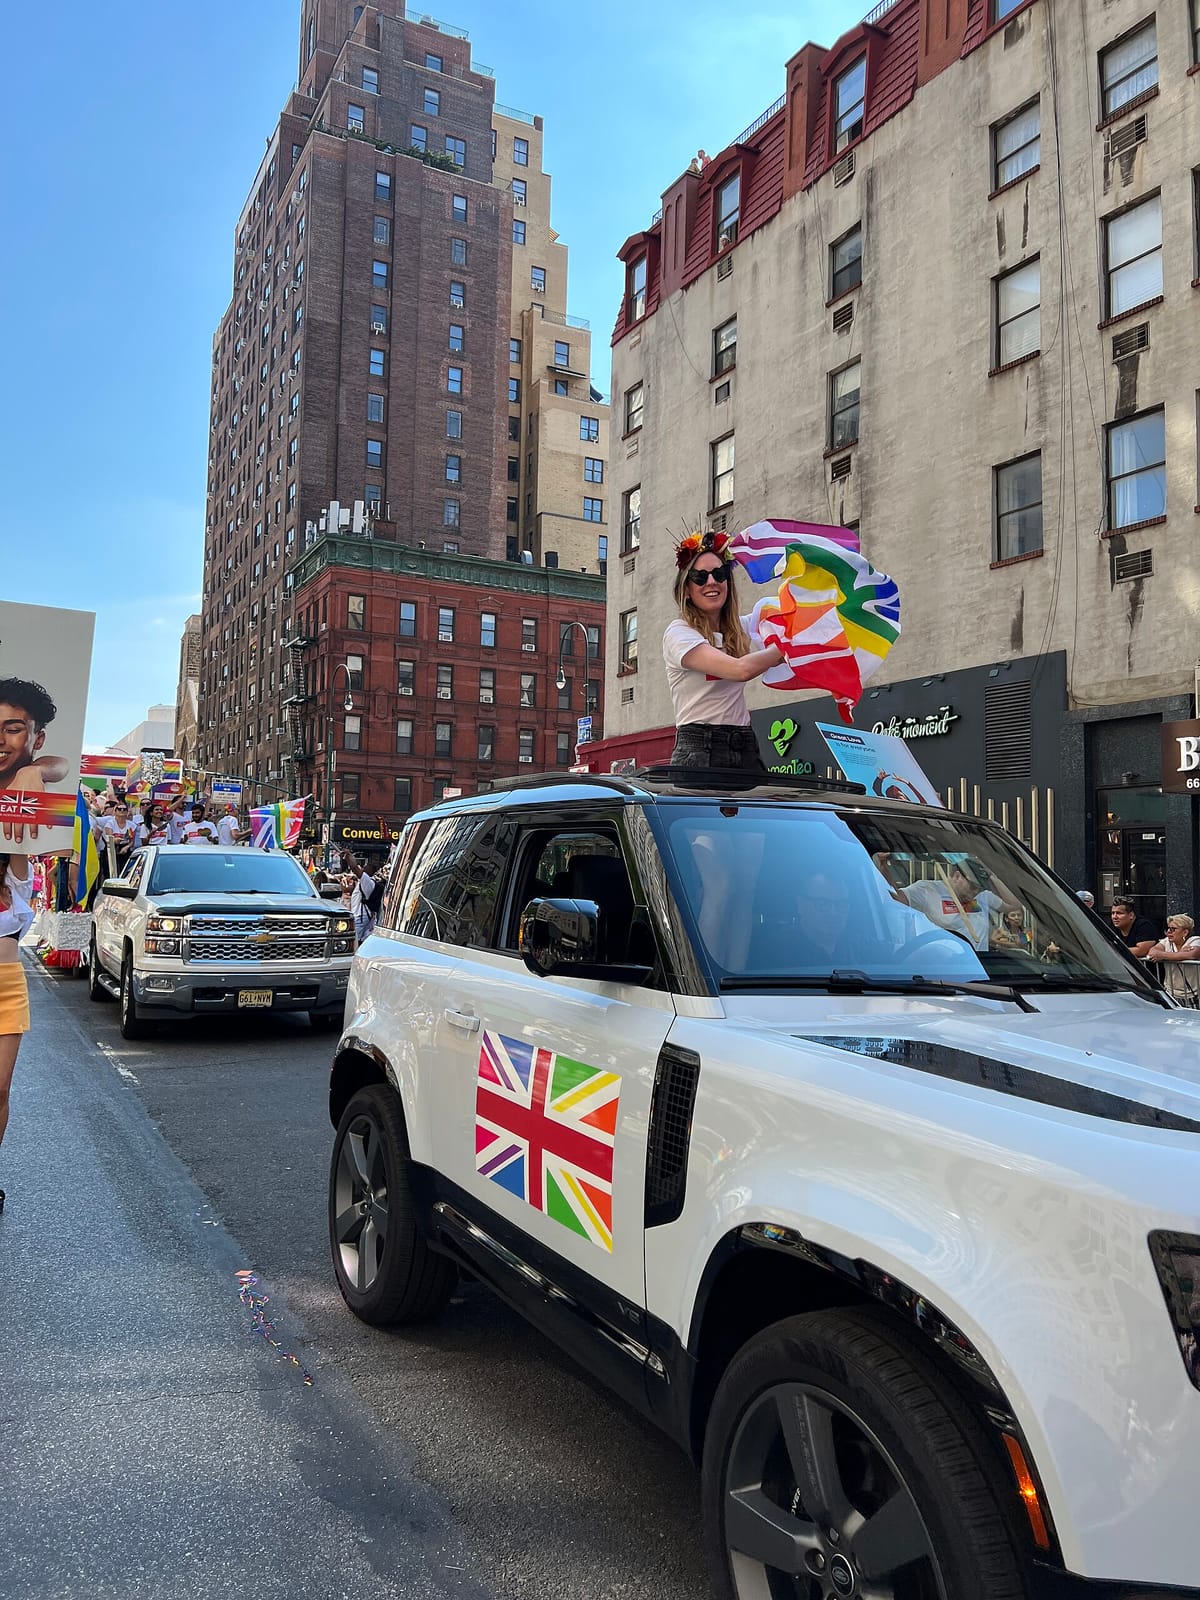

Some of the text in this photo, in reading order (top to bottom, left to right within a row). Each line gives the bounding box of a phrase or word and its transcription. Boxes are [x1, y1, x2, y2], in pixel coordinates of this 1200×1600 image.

[902, 709, 958, 738] moment
[767, 759, 812, 775] menTea
[1176, 736, 1200, 772] B
